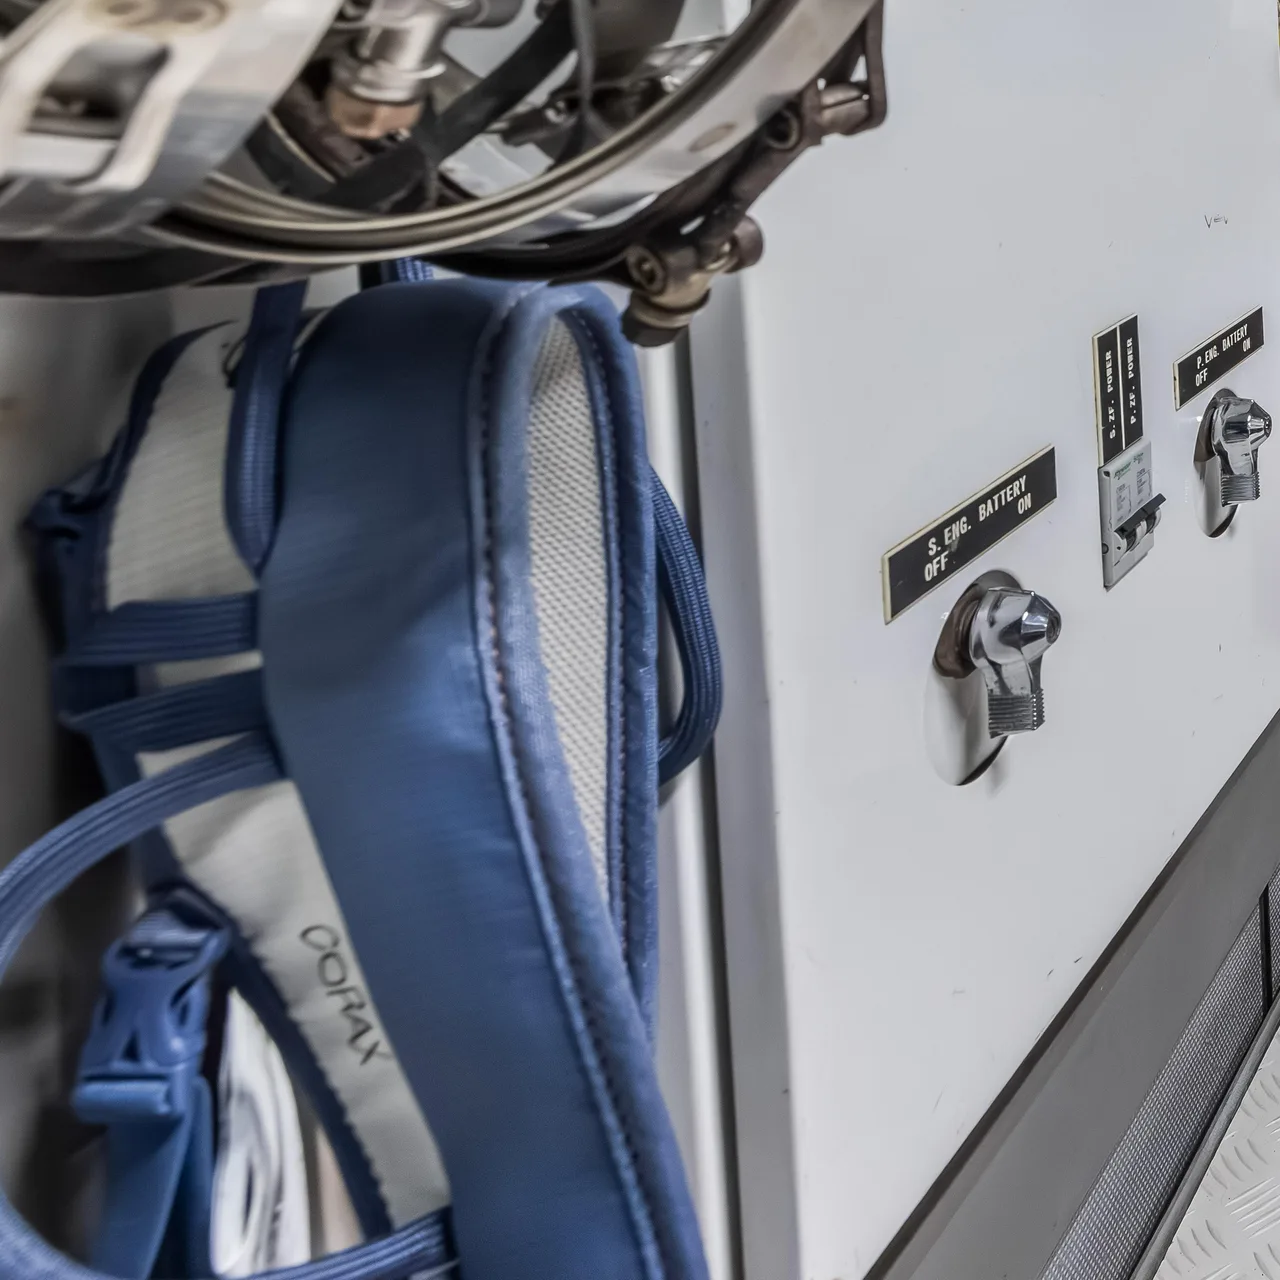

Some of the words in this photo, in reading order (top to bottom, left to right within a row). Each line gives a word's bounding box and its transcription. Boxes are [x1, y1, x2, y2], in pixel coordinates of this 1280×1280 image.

[1126, 336, 1135, 384] POWER
[1196, 355, 1204, 369] P.
[1205, 345, 1220, 364] ENG.
[1222, 323, 1249, 352] BATTERY
[1242, 337, 1251, 352] ON
[1105, 349, 1114, 395] POWER
[1195, 368, 1208, 387] OFF
[926, 536, 942, 557] S.
[944, 518, 972, 549] ENG.
[977, 474, 1028, 522] BATTERY
[1016, 491, 1032, 514] ON
[923, 551, 949, 583] OFF
